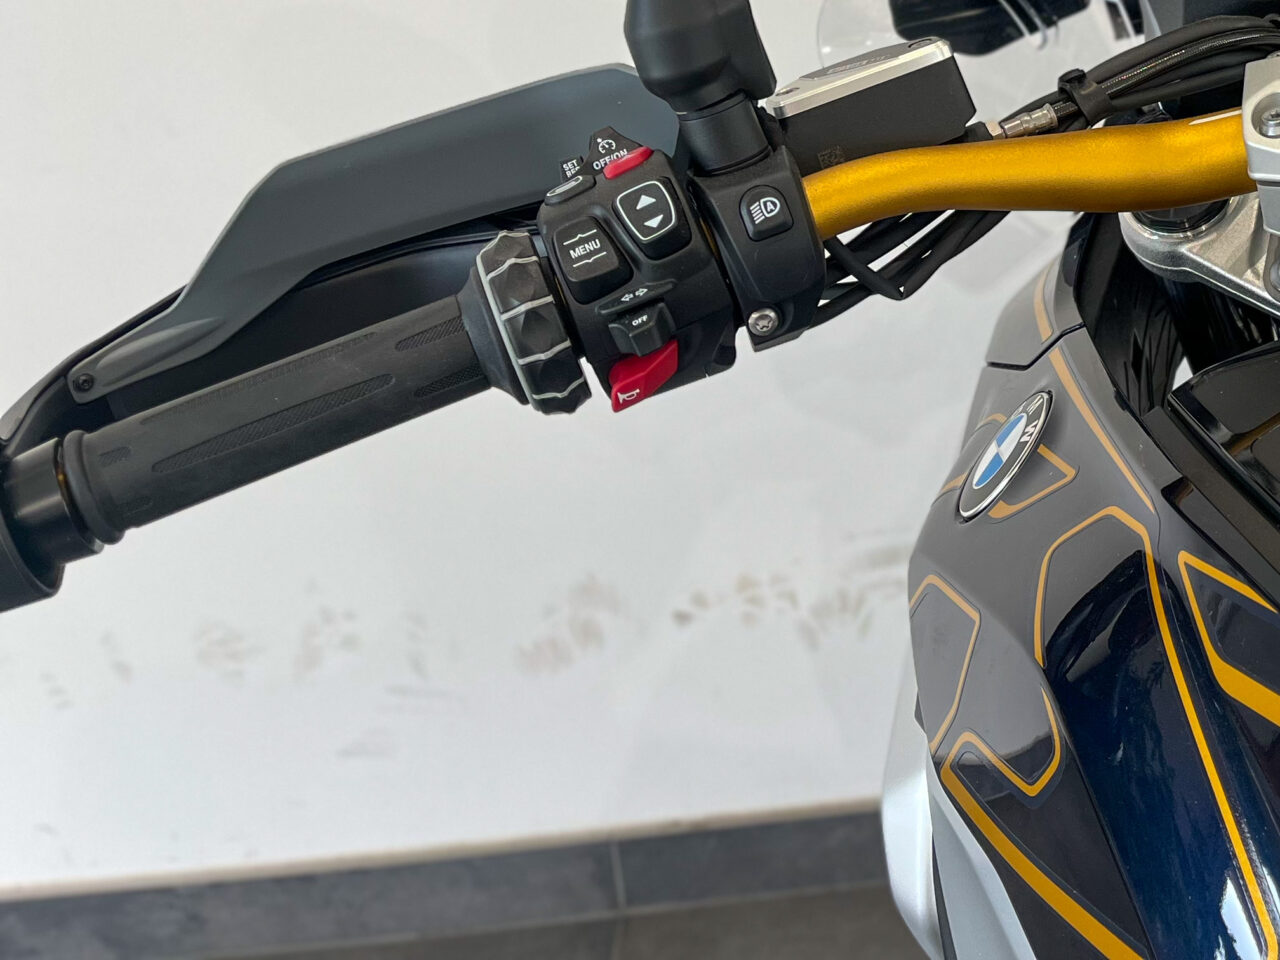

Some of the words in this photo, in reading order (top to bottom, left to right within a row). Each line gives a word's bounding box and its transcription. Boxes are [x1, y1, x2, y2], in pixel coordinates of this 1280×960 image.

[563, 159, 578, 171] SET
[569, 239, 600, 259] MENU
[632, 315, 648, 326] OFF
